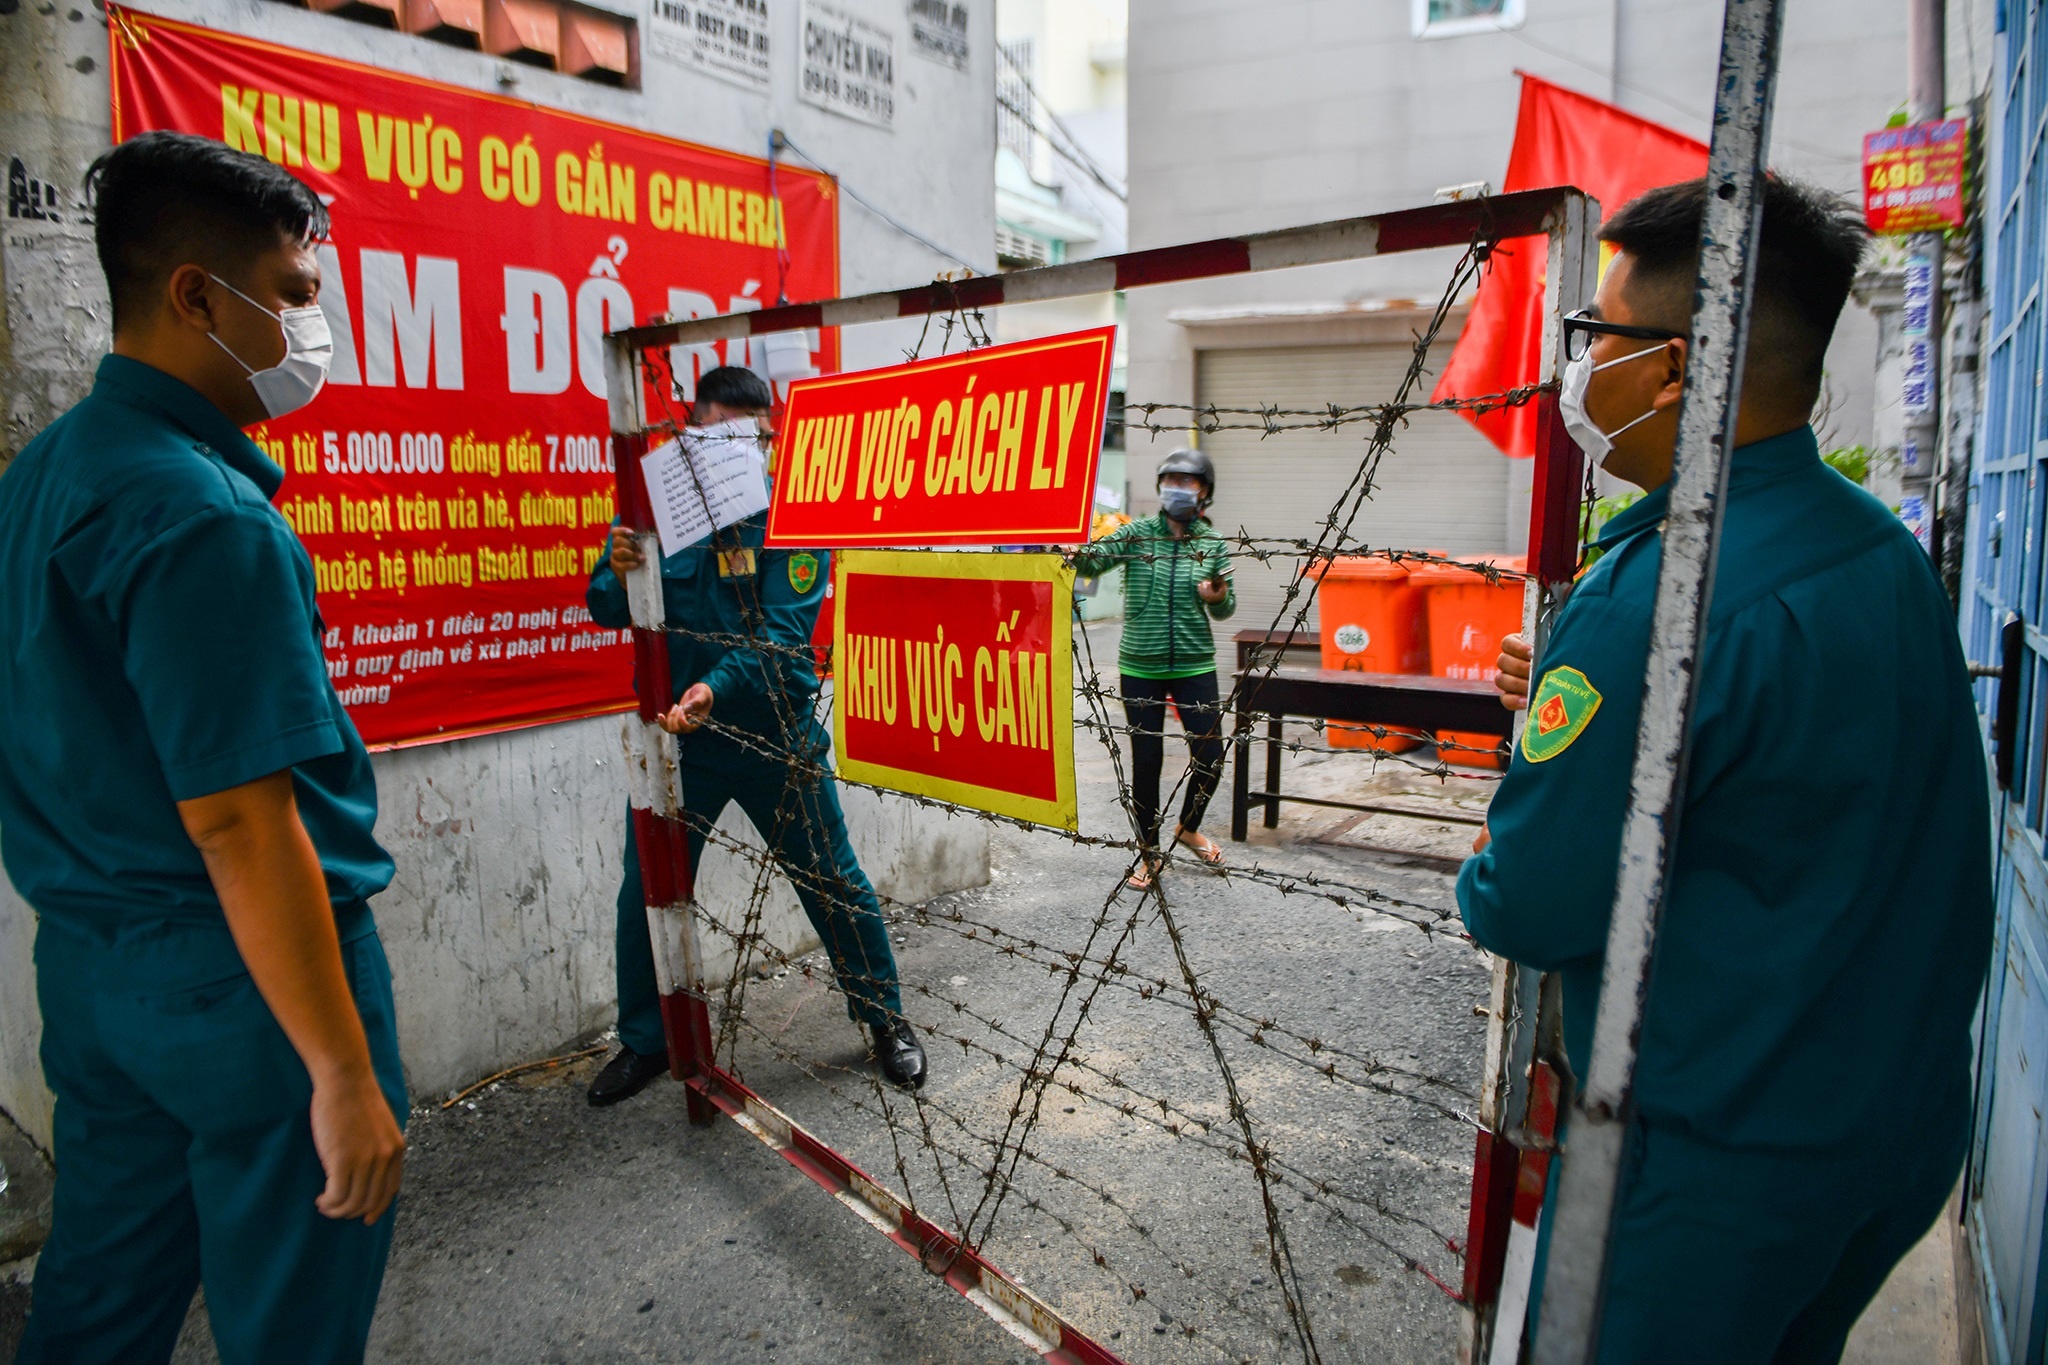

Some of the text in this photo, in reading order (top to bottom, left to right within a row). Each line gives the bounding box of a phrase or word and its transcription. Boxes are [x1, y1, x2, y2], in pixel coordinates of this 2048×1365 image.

[221, 82, 787, 249] KHU VỰC CÓ GẮN CAMERA
[500, 236, 636, 400] ĐỔ
[292, 431, 318, 474] từ
[323, 430, 444, 474] 5.000.000
[450, 430, 500, 477] đồng
[506, 430, 542, 473] đến
[786, 413, 854, 503] KHU
[855, 397, 921, 521] VỰC
[924, 373, 1028, 497] CÁCH
[1029, 382, 1085, 490] LY
[282, 493, 334, 534] sinh
[340, 492, 392, 541] hoạt
[397, 490, 441, 531] trên
[446, 486, 478, 529] vỉa
[484, 489, 514, 531] hè,
[519, 490, 576, 529] đường
[582, 485, 616, 528] phố
[314, 550, 373, 599] hoặc
[379, 549, 407, 596] hệ
[413, 541, 473, 588] thống
[478, 542, 529, 582] thoát
[533, 541, 578, 579] nước
[326, 654, 349, 679] hủ
[354, 653, 395, 677] quy
[398, 646, 445, 674] định
[450, 639, 473, 664] về
[478, 637, 503, 661] xử
[506, 635, 547, 660] phạt
[551, 632, 567, 651] vi
[570, 630, 618, 652] phạm
[352, 618, 418, 645] khoản
[425, 618, 435, 639] 1
[442, 610, 485, 637] điều
[489, 611, 513, 632] 20
[518, 607, 558, 630] nghị
[562, 606, 594, 628] địn
[847, 609, 1049, 753] KHU VỰC CẤM
